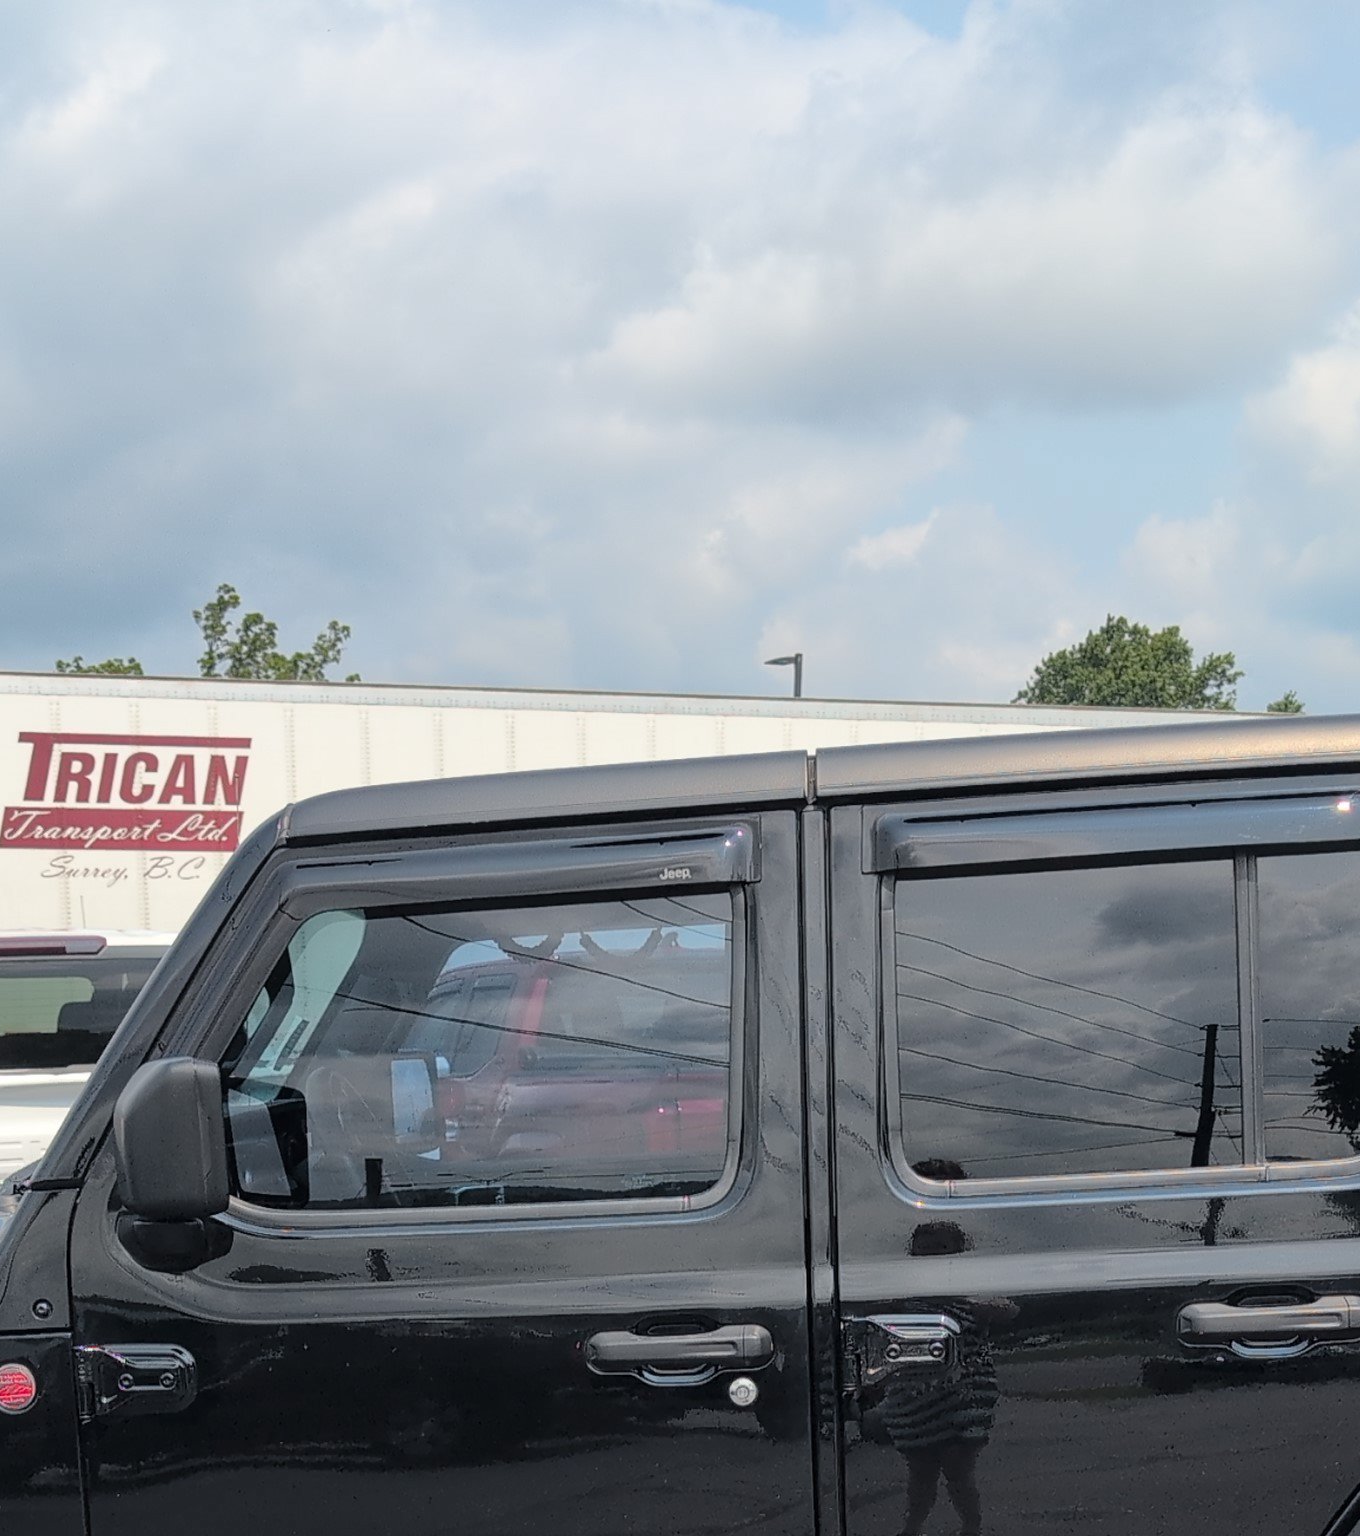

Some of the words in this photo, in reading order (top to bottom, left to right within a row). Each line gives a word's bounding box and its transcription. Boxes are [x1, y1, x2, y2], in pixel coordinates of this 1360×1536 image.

[18, 732, 252, 806] TRICAN
[3, 811, 161, 848] Transport
[158, 813, 238, 842] Ltd.
[41, 855, 128, 888] Surrey,
